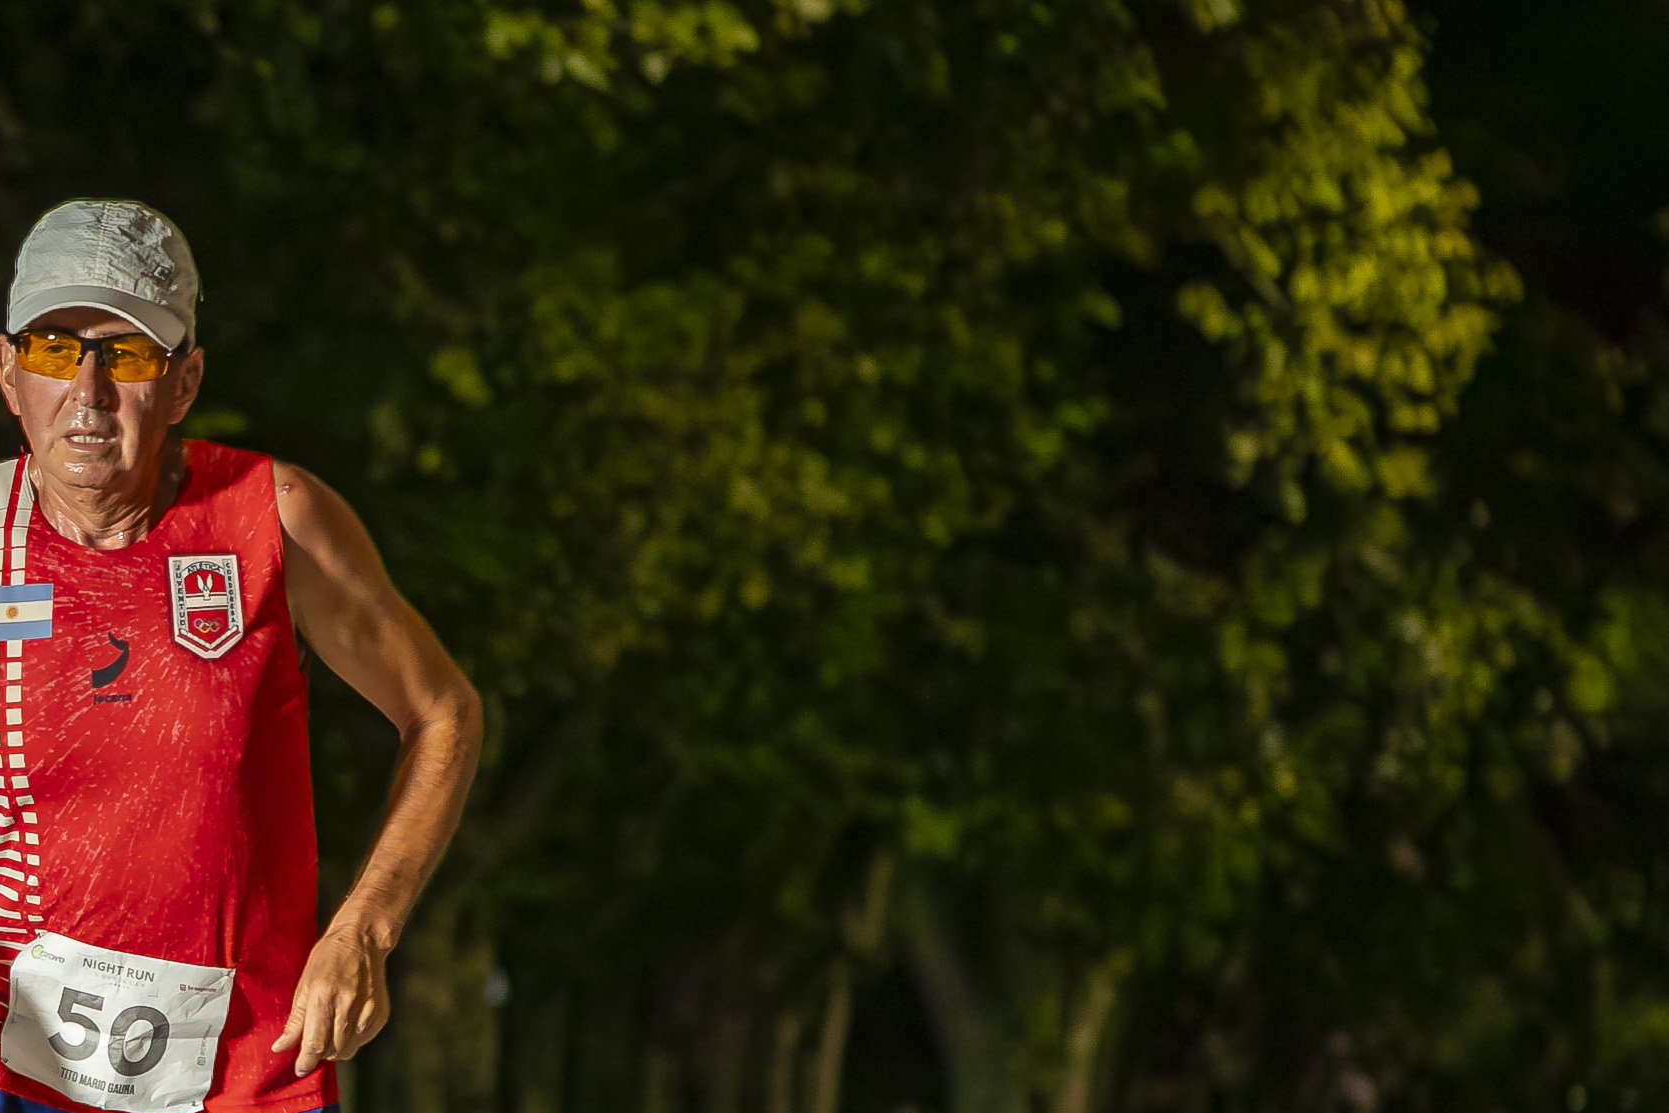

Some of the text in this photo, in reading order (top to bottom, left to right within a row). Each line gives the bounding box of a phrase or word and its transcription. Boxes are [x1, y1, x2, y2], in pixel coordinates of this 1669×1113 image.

[82, 957, 124, 976] NIGHT
[126, 967, 155, 983] RUN
[48, 986, 170, 1077] 50
[60, 1066, 79, 1083] TITO
[78, 1073, 106, 1092] MARIO
